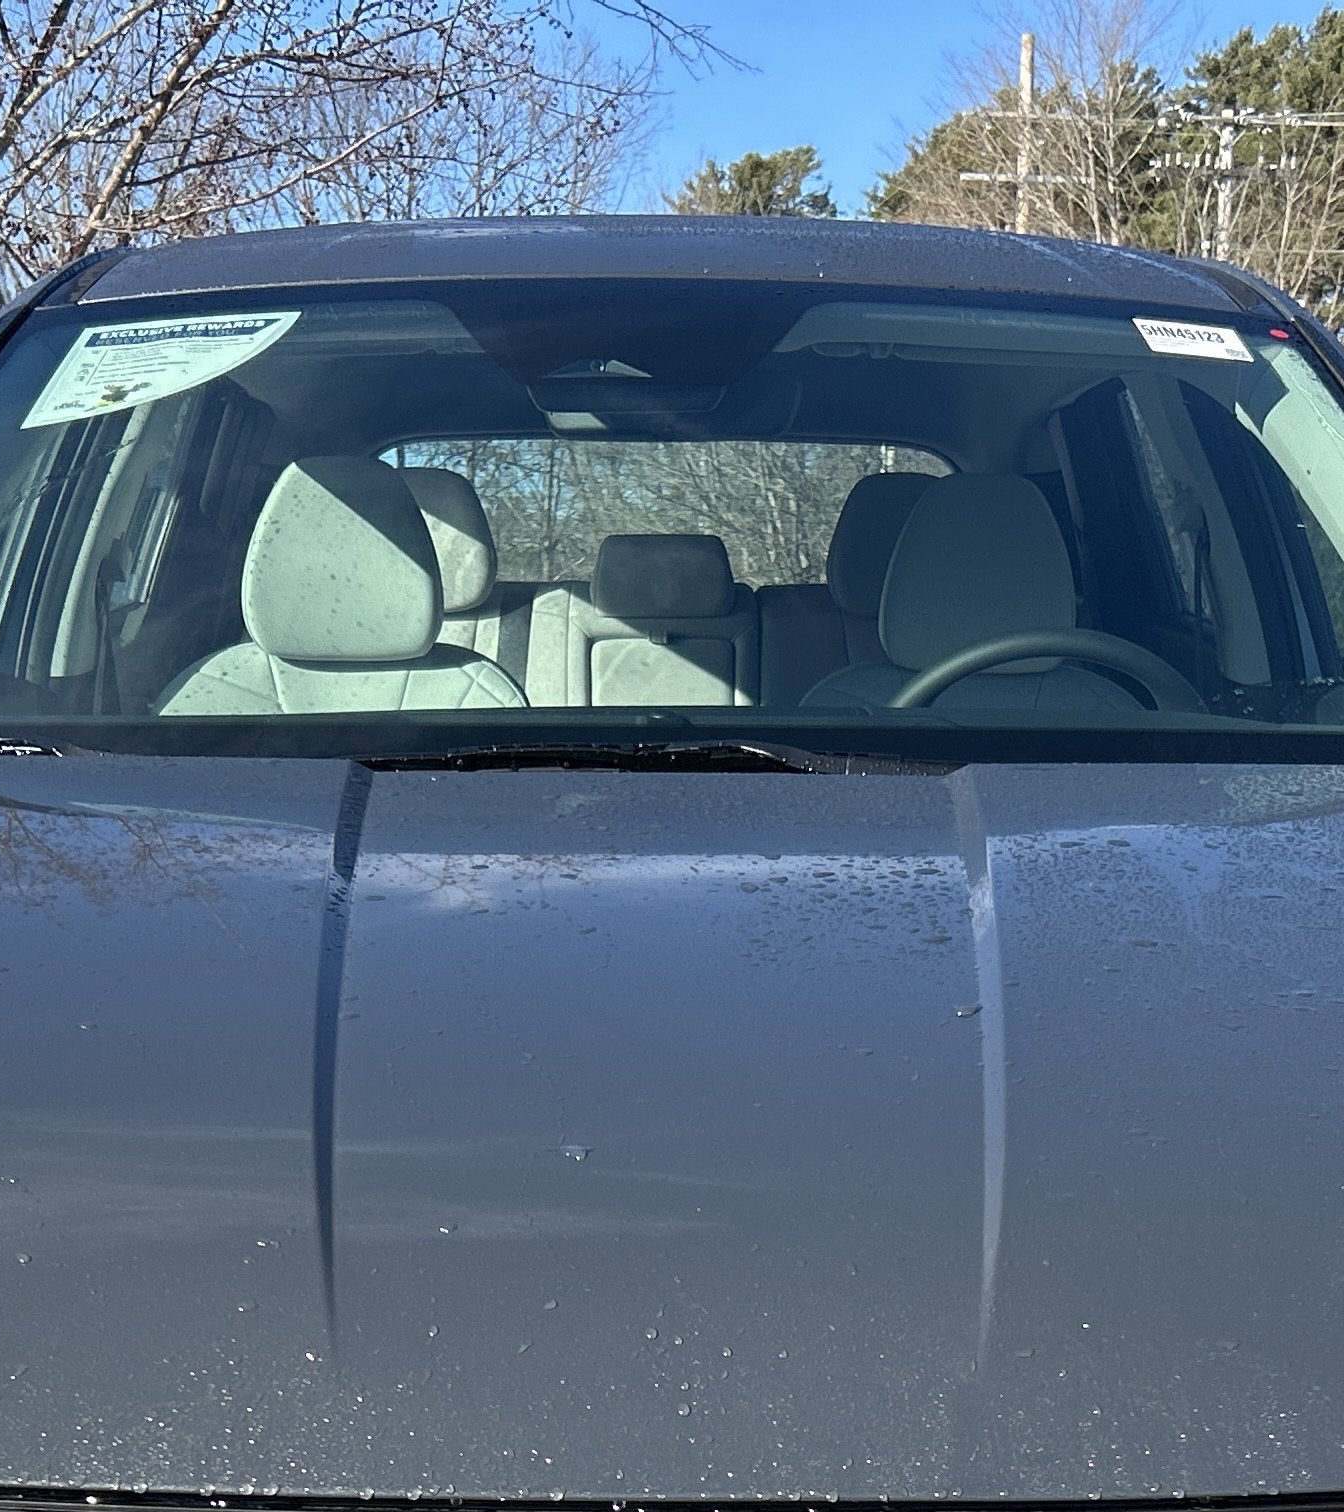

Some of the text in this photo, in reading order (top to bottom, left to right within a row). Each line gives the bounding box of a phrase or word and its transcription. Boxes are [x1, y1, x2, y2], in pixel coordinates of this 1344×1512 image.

[98, 319, 267, 341] EXCLUSIVE REWARDS
[1140, 324, 1226, 344] 5HN45123
